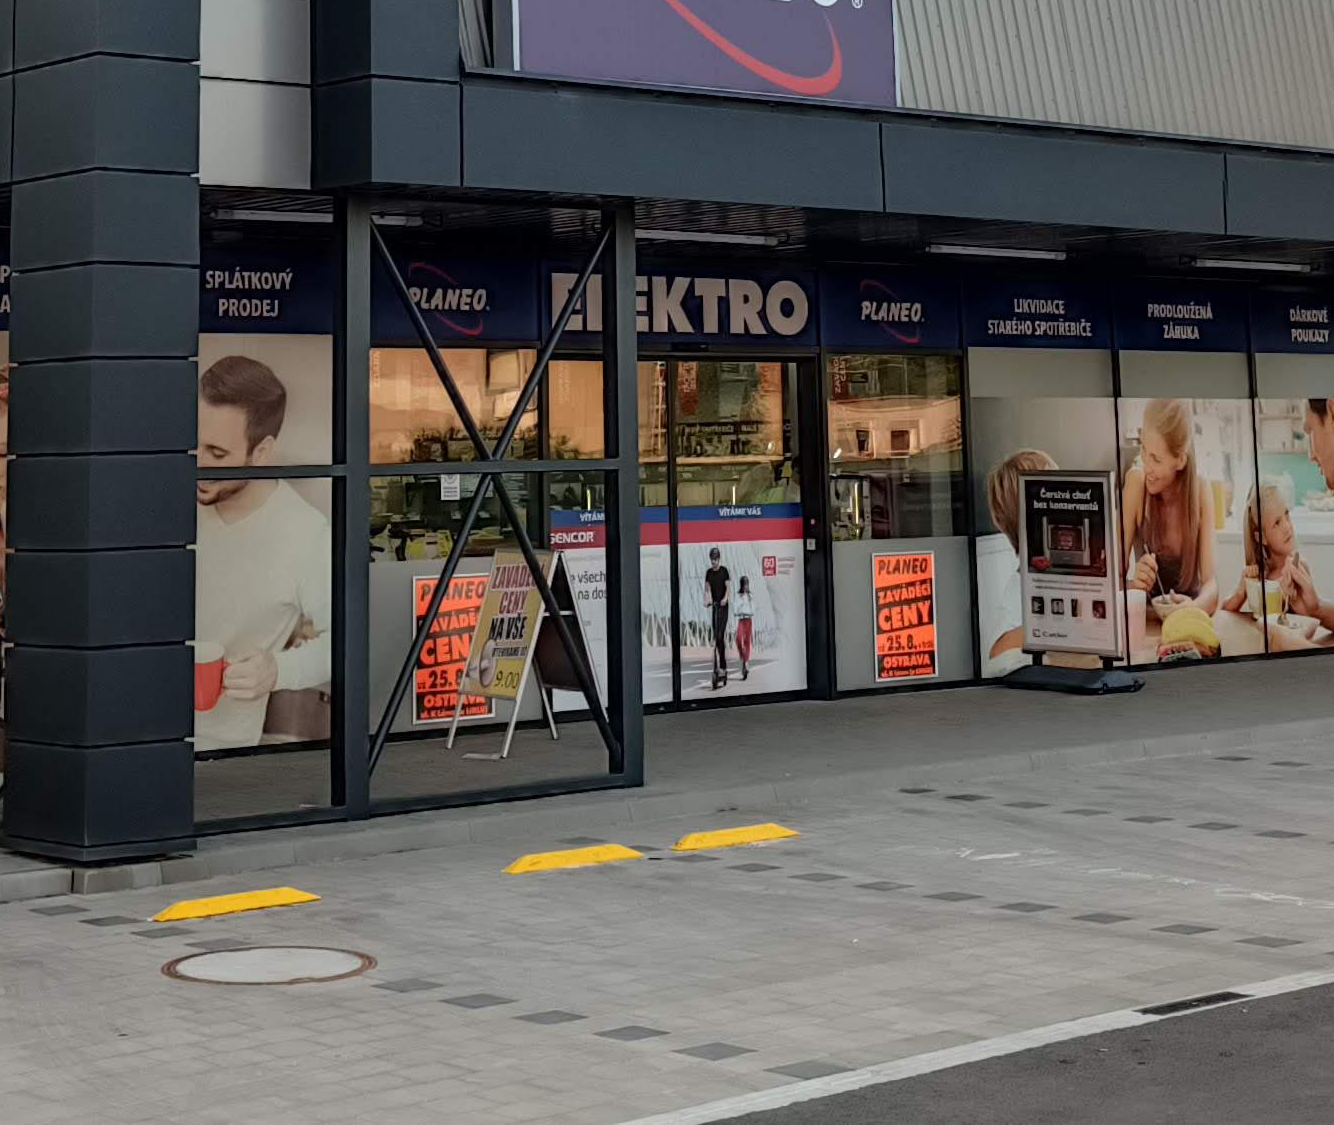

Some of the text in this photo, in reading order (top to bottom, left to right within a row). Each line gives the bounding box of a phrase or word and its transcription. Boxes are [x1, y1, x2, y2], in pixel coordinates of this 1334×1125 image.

[205, 267, 293, 290] SPLÁTKOVÝ
[218, 298, 280, 318] PRODEJ
[408, 286, 487, 312] PLANEO
[1013, 298, 1066, 315] LIKVIDACE
[860, 300, 922, 323] PLANEO
[1147, 301, 1214, 321] PRODLOUŽENÁ
[1289, 304, 1329, 323] DÁRKOVÉ
[987, 317, 1093, 338] STARÉHO SPOTŘEBIČE
[1163, 321, 1200, 340] ZÁRUKA
[1290, 324, 1331, 344] POUKAZY
[1033, 500, 1048, 509] bez
[550, 531, 594, 544] SENCOR
[878, 558, 928, 576] PLANEO
[421, 581, 485, 603] PNEO
[498, 590, 528, 614] CENY
[578, 590, 590, 600] na
[877, 579, 931, 605] ZAVÁDĚCÍ
[878, 600, 932, 632] CENY
[489, 614, 528, 641] NA VŠE
[419, 633, 474, 666] CEN
[883, 653, 931, 669] OSTRAVA
